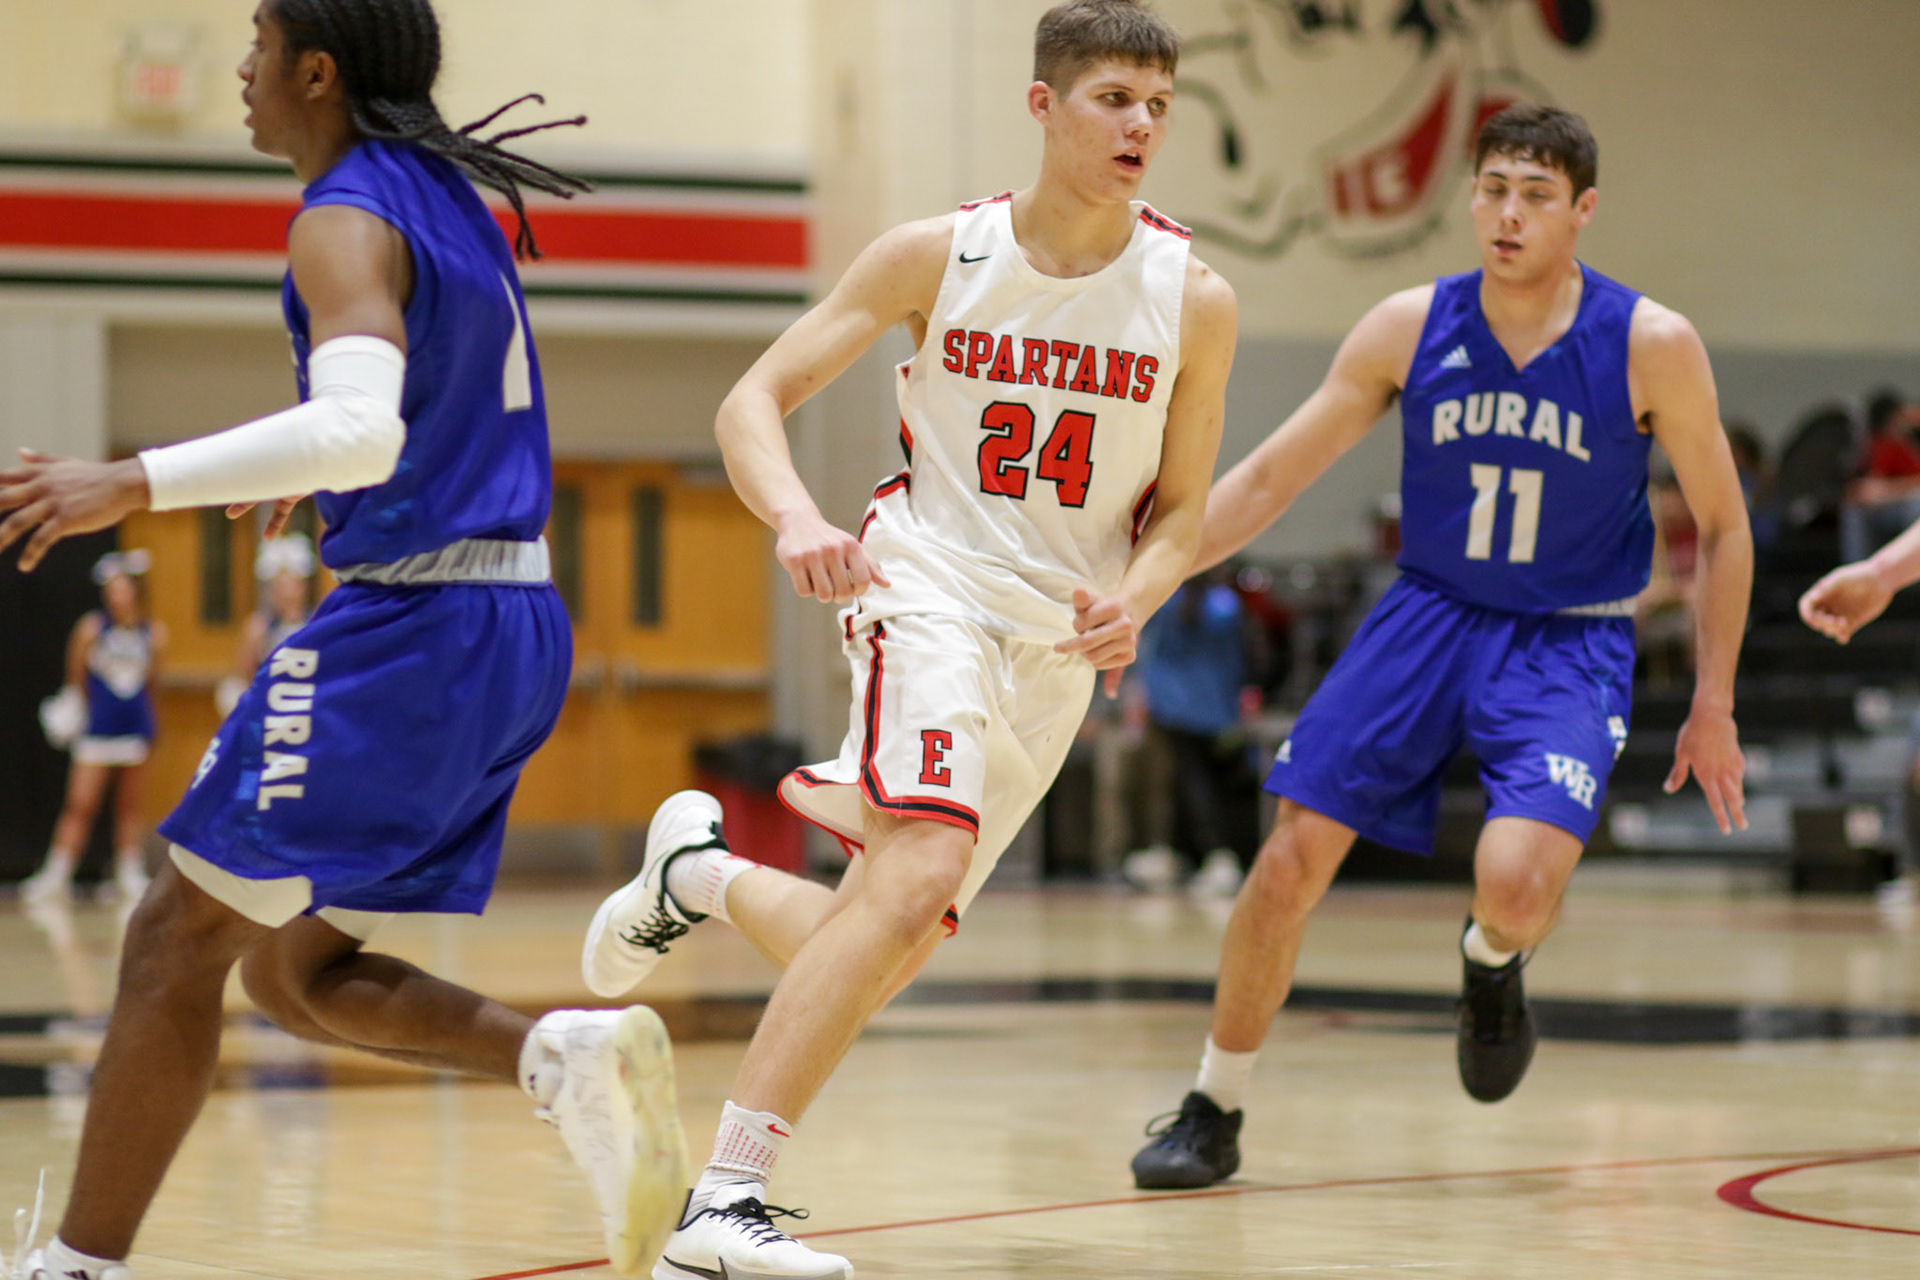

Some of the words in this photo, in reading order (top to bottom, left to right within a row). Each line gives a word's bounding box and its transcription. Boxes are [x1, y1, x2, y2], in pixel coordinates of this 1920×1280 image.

[943, 329, 1159, 403] SPARTANS
[977, 400, 1096, 509] 24
[1432, 391, 1591, 463] RURAL
[1465, 463, 1544, 563] 11
[257, 647, 320, 811] RURAL
[919, 729, 952, 788] E
